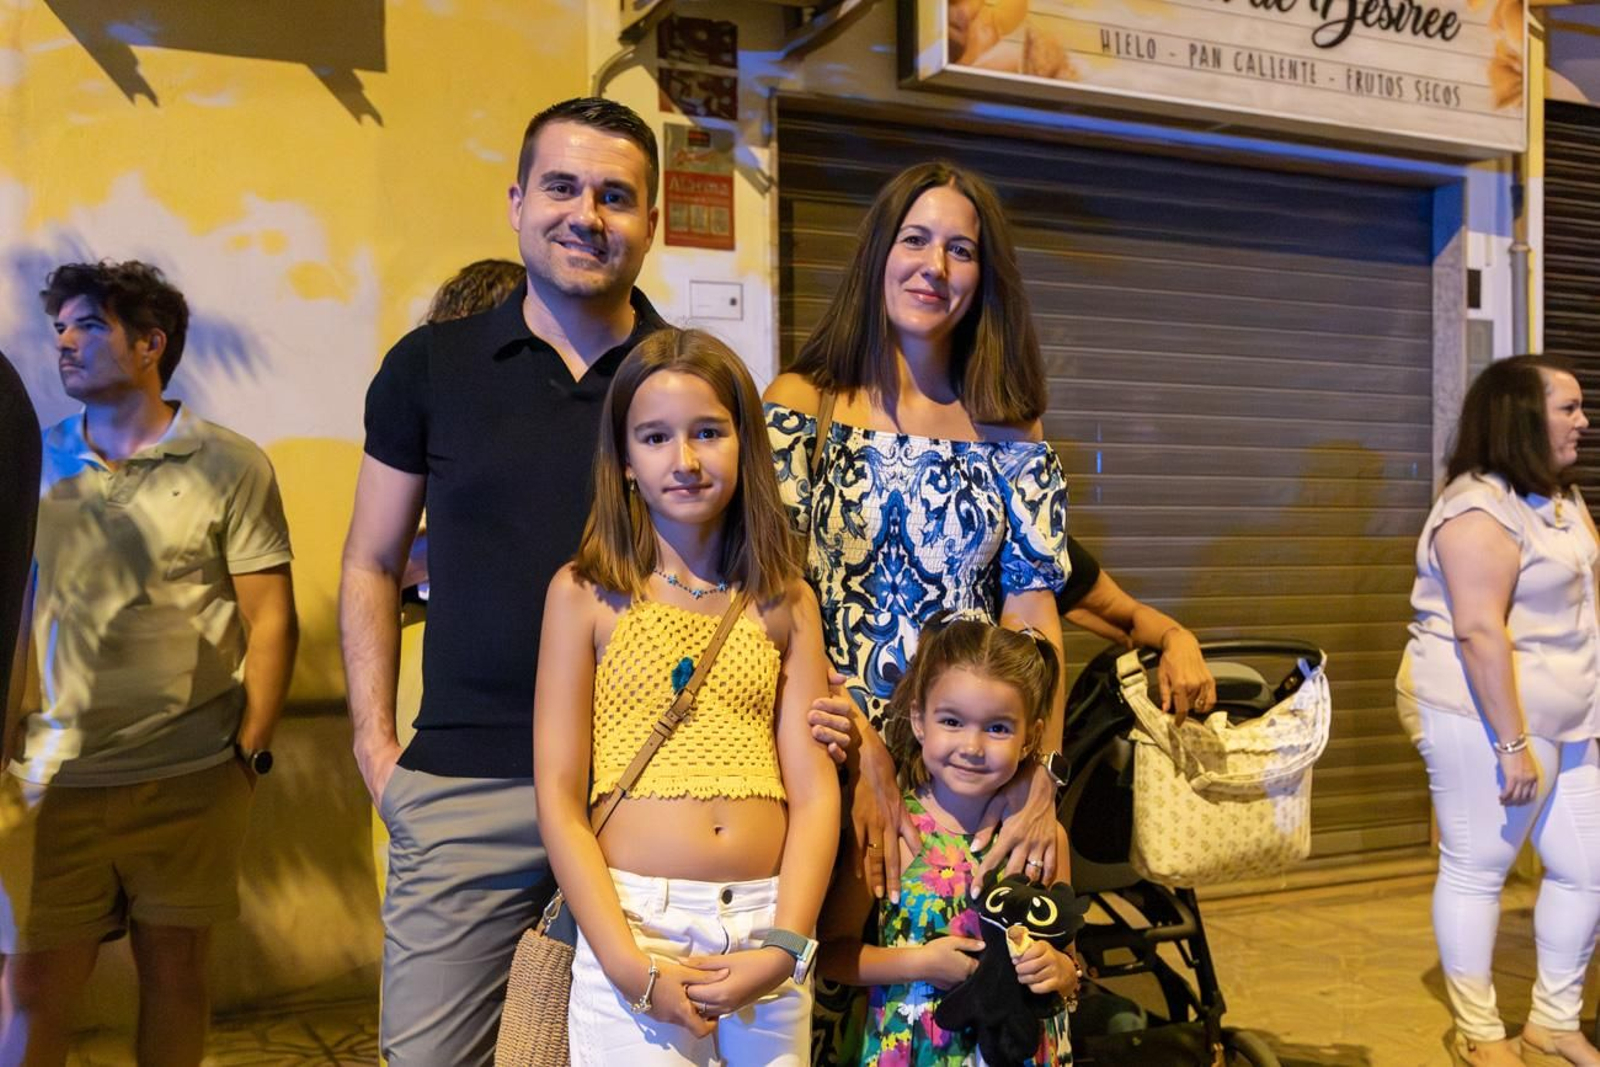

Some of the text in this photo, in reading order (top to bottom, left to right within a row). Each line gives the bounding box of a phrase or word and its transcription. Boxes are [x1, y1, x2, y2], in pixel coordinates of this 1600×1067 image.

[1100, 29, 1156, 60] HIELO
[1189, 43, 1222, 69] PAN
[1233, 52, 1316, 85] CALIENTE
[1346, 68, 1403, 99] FRUTOS
[1414, 79, 1461, 107] SECOS
